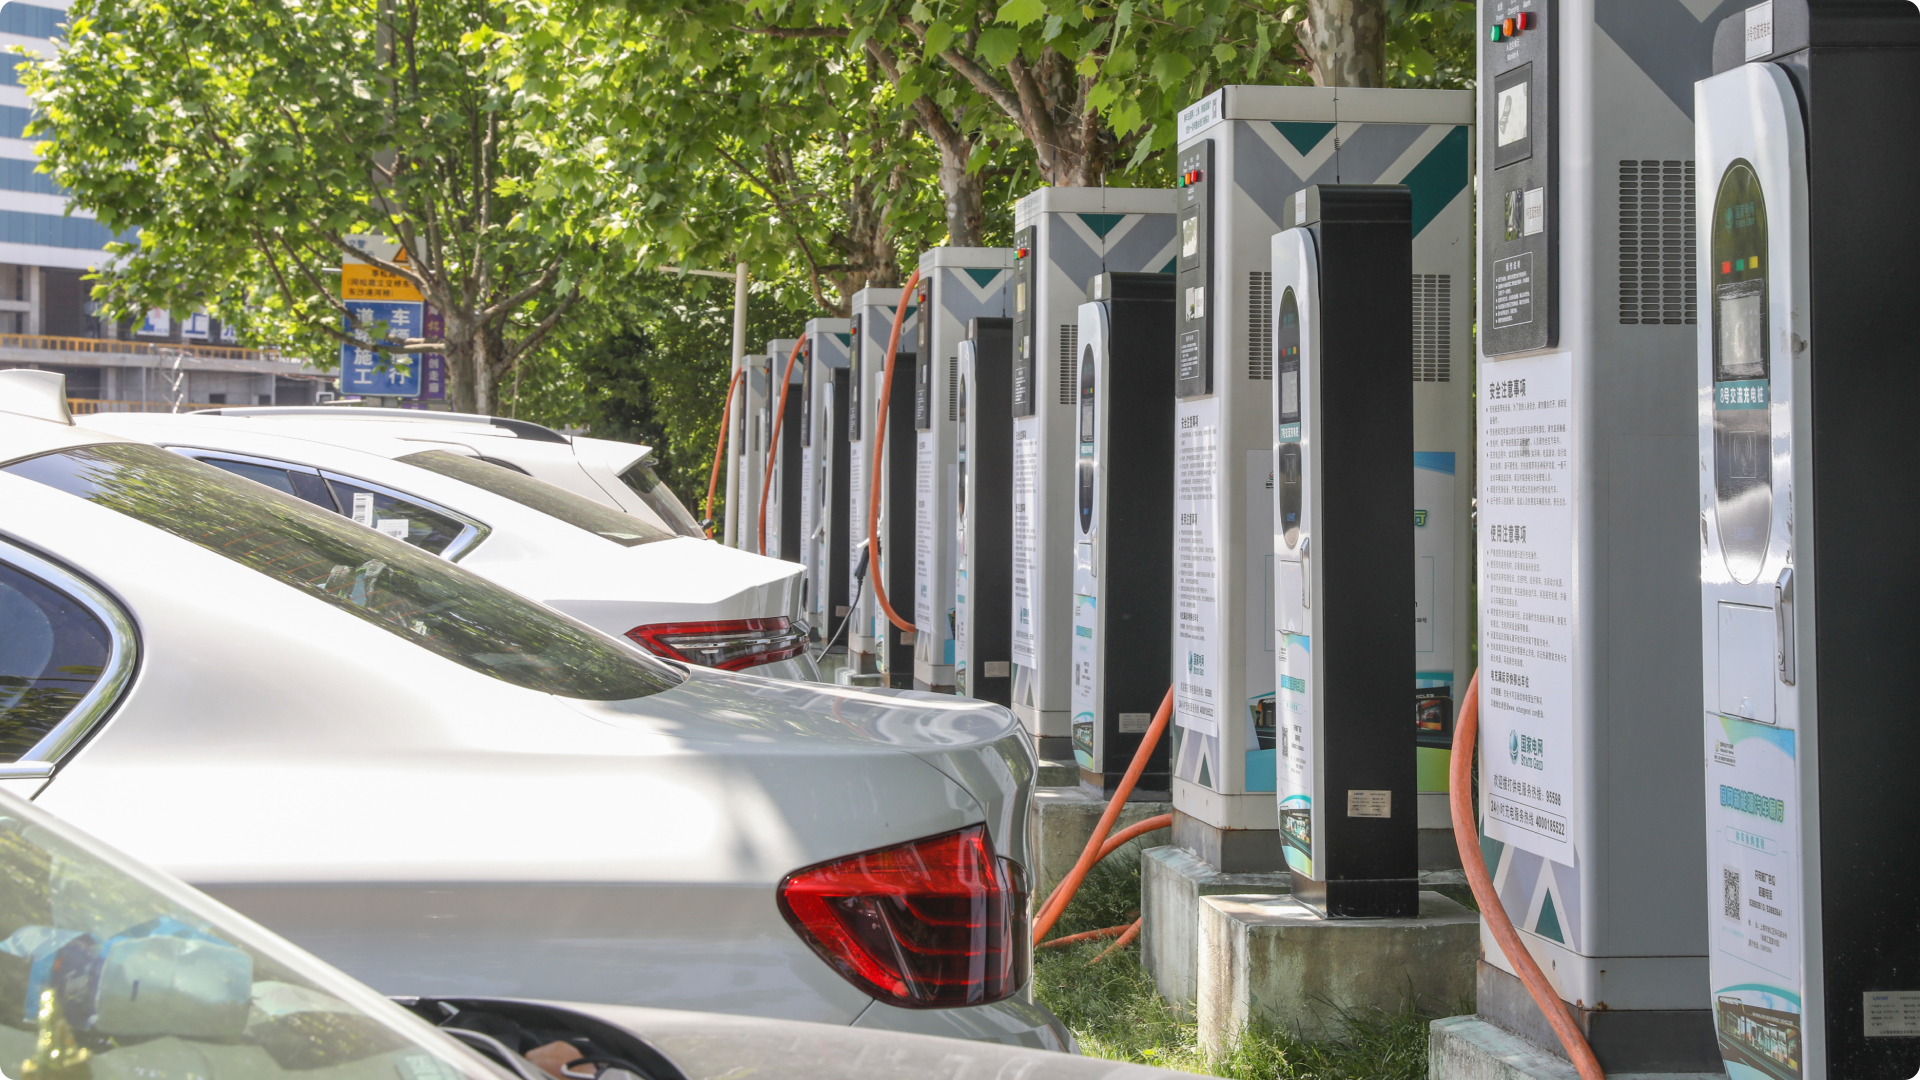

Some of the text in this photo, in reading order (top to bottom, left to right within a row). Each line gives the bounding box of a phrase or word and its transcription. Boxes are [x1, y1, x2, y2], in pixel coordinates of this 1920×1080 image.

[1490, 379, 1526, 400] 安全注意事项
[1490, 525, 1527, 544] 使用注意事项
[1521, 733, 1544, 758] 国家电网
[1545, 790, 1562, 807] 95598
